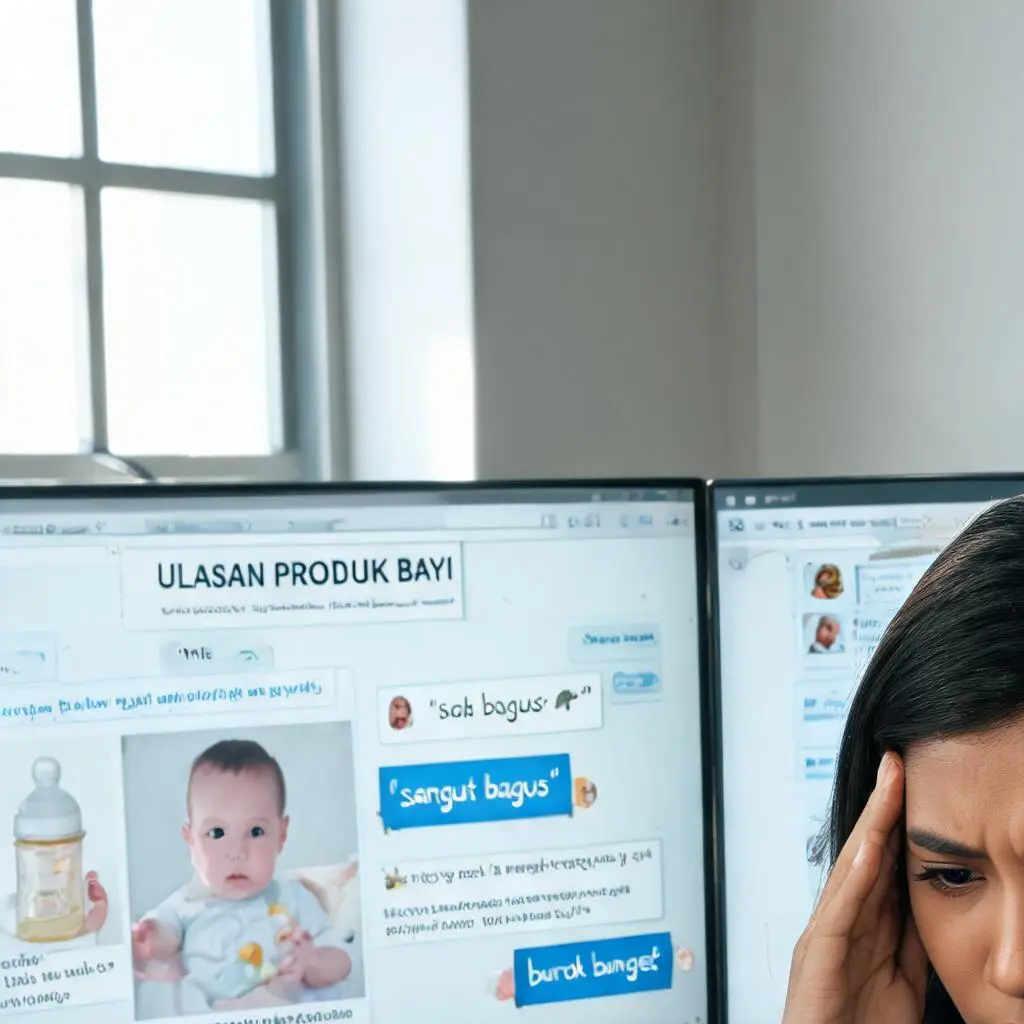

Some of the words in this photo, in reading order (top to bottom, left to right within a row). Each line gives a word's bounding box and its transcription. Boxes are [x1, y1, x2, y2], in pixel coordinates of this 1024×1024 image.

[157, 561, 265, 590] ULASAN
[274, 557, 390, 587] PRODUK
[397, 555, 454, 583] BAYI
